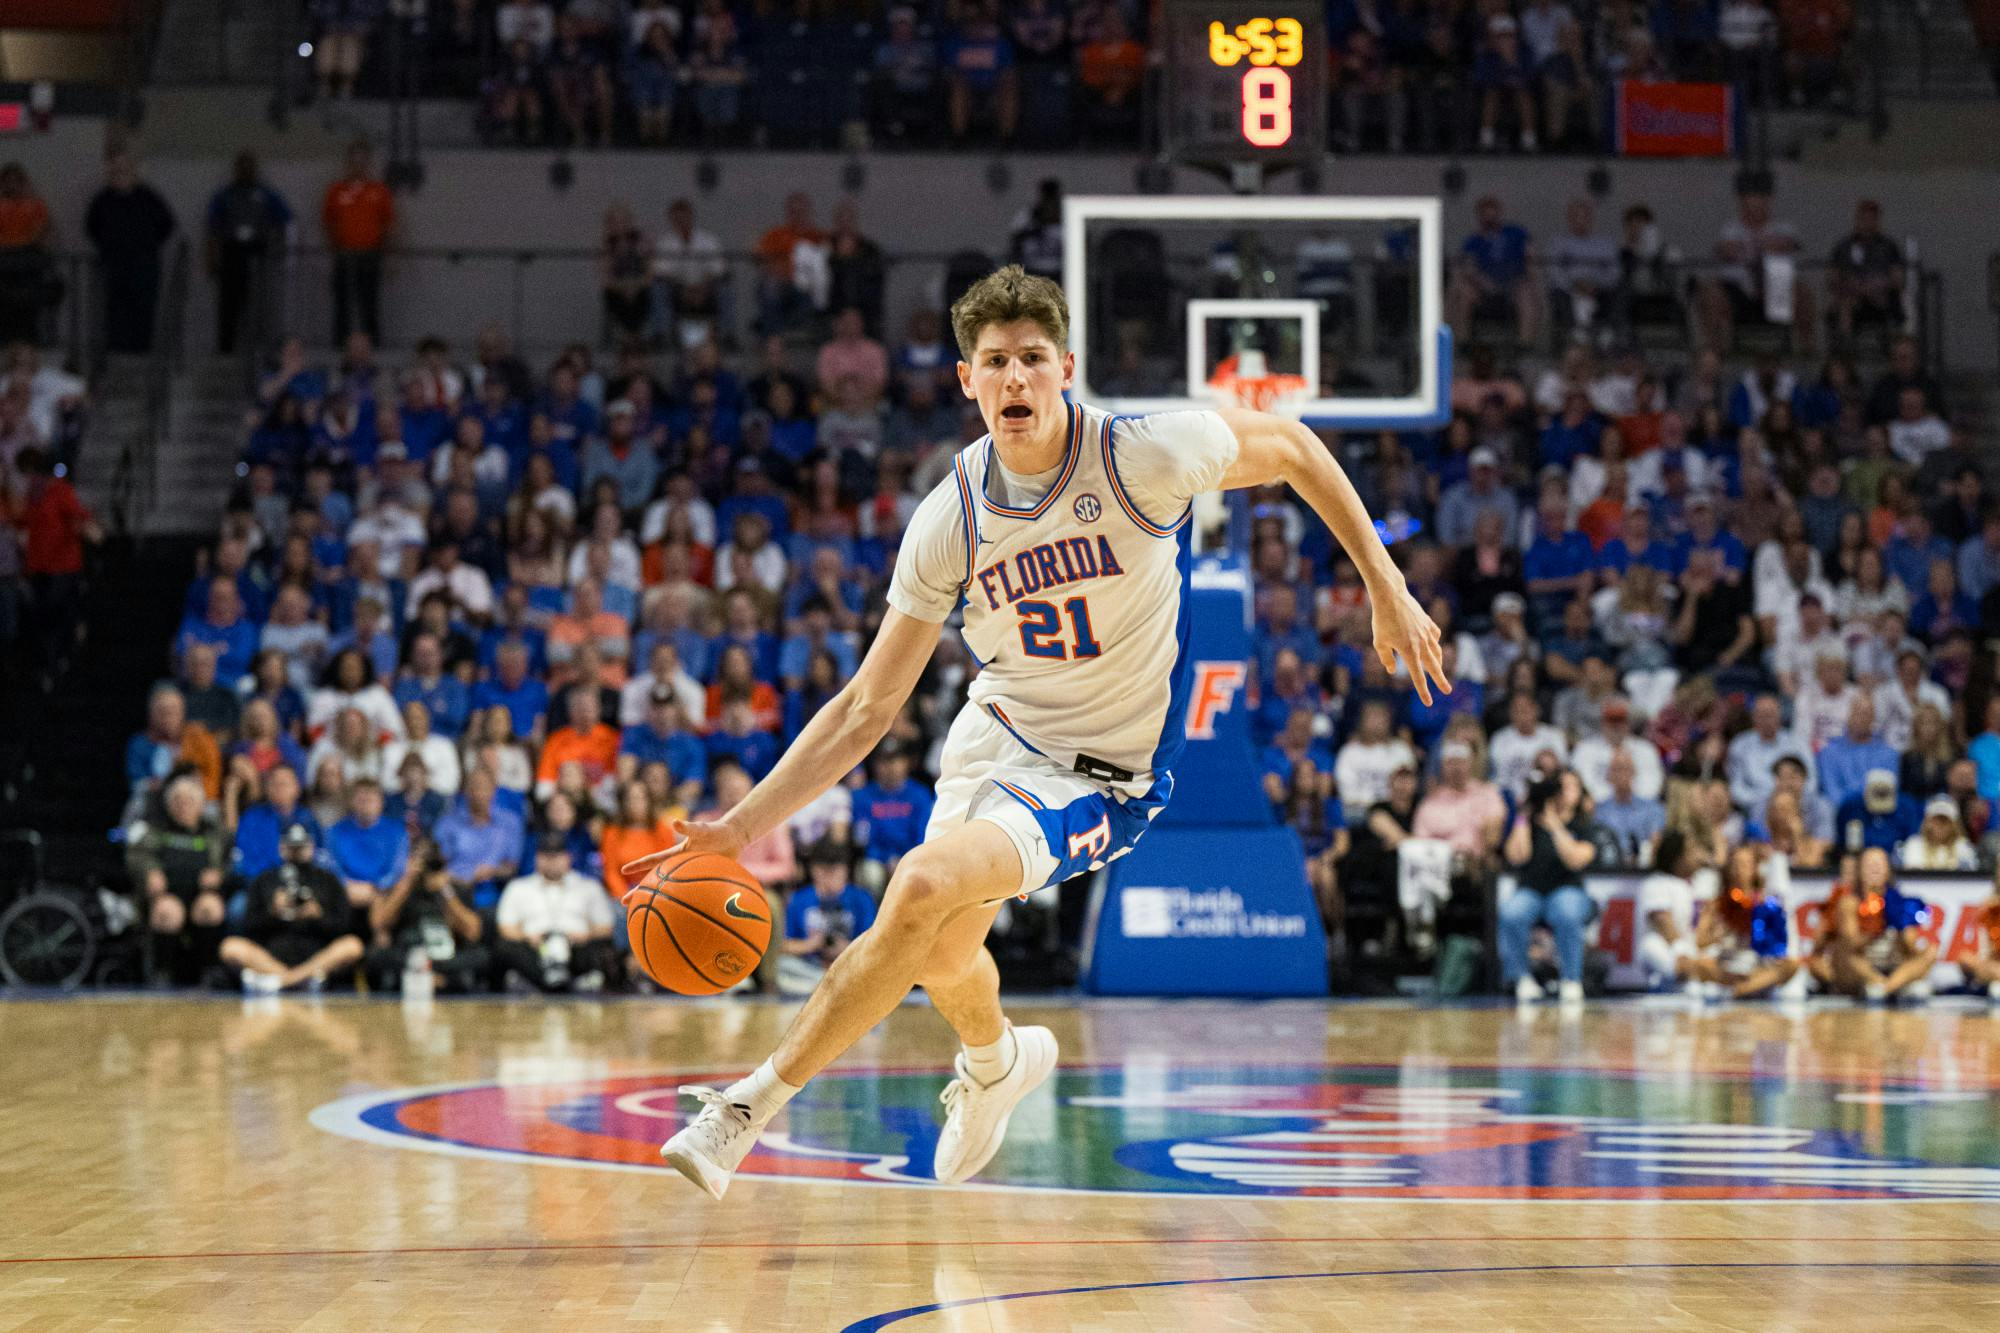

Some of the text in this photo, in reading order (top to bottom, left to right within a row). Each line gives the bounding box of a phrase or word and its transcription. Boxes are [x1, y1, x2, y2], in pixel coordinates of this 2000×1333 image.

[1208, 17, 1303, 66] 6:53
[1242, 66, 1292, 147] 8
[1074, 494, 1101, 522] SEC
[977, 534, 1124, 611] FLORIDA
[1015, 596, 1103, 661] 21
[1185, 661, 1246, 740] F
